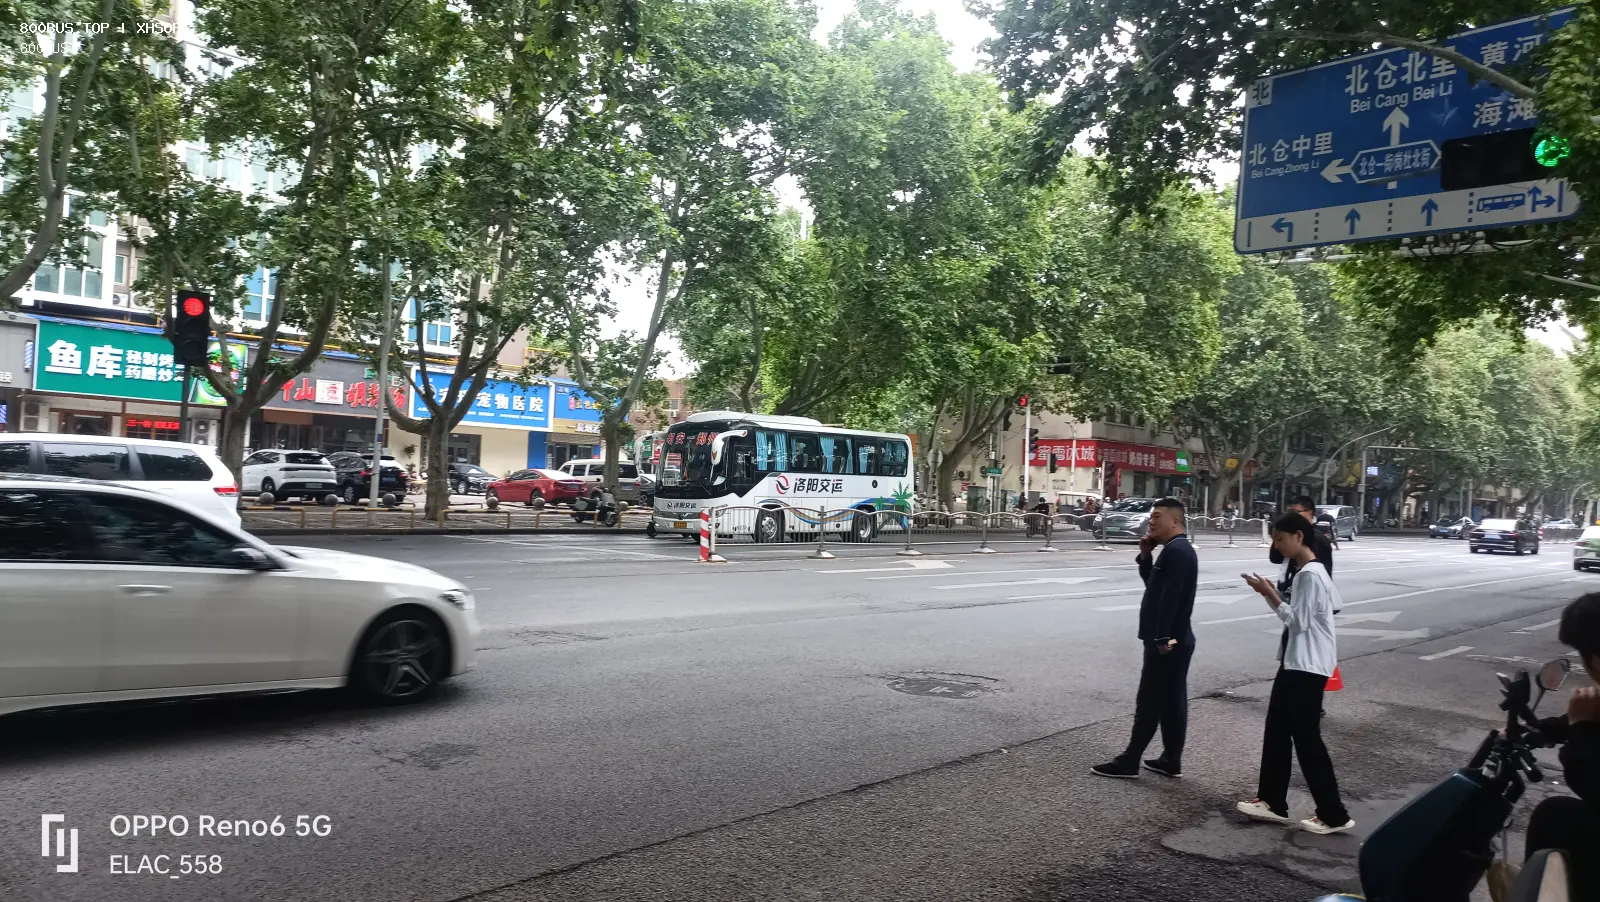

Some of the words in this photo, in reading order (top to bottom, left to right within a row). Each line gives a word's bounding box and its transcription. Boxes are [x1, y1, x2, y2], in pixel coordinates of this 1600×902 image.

[1344, 45, 1458, 96] 北仓北里
[1252, 82, 1269, 101] 北
[1350, 98, 1371, 114] Bei
[1375, 92, 1409, 109] Cang
[1413, 84, 1436, 102] Bei
[1439, 80, 1453, 97] Li
[1248, 131, 1334, 167] 北仓中里
[1251, 169, 1264, 179] Bei
[1265, 166, 1285, 178] Cang
[1284, 162, 1310, 175] Zhong
[1311, 159, 1320, 169] Li
[45, 339, 124, 379] 鱼库
[125, 350, 185, 369] 秘制烤
[1037, 445, 1094, 461] 蜜雪冰城
[794, 477, 844, 494] 洛阳交运
